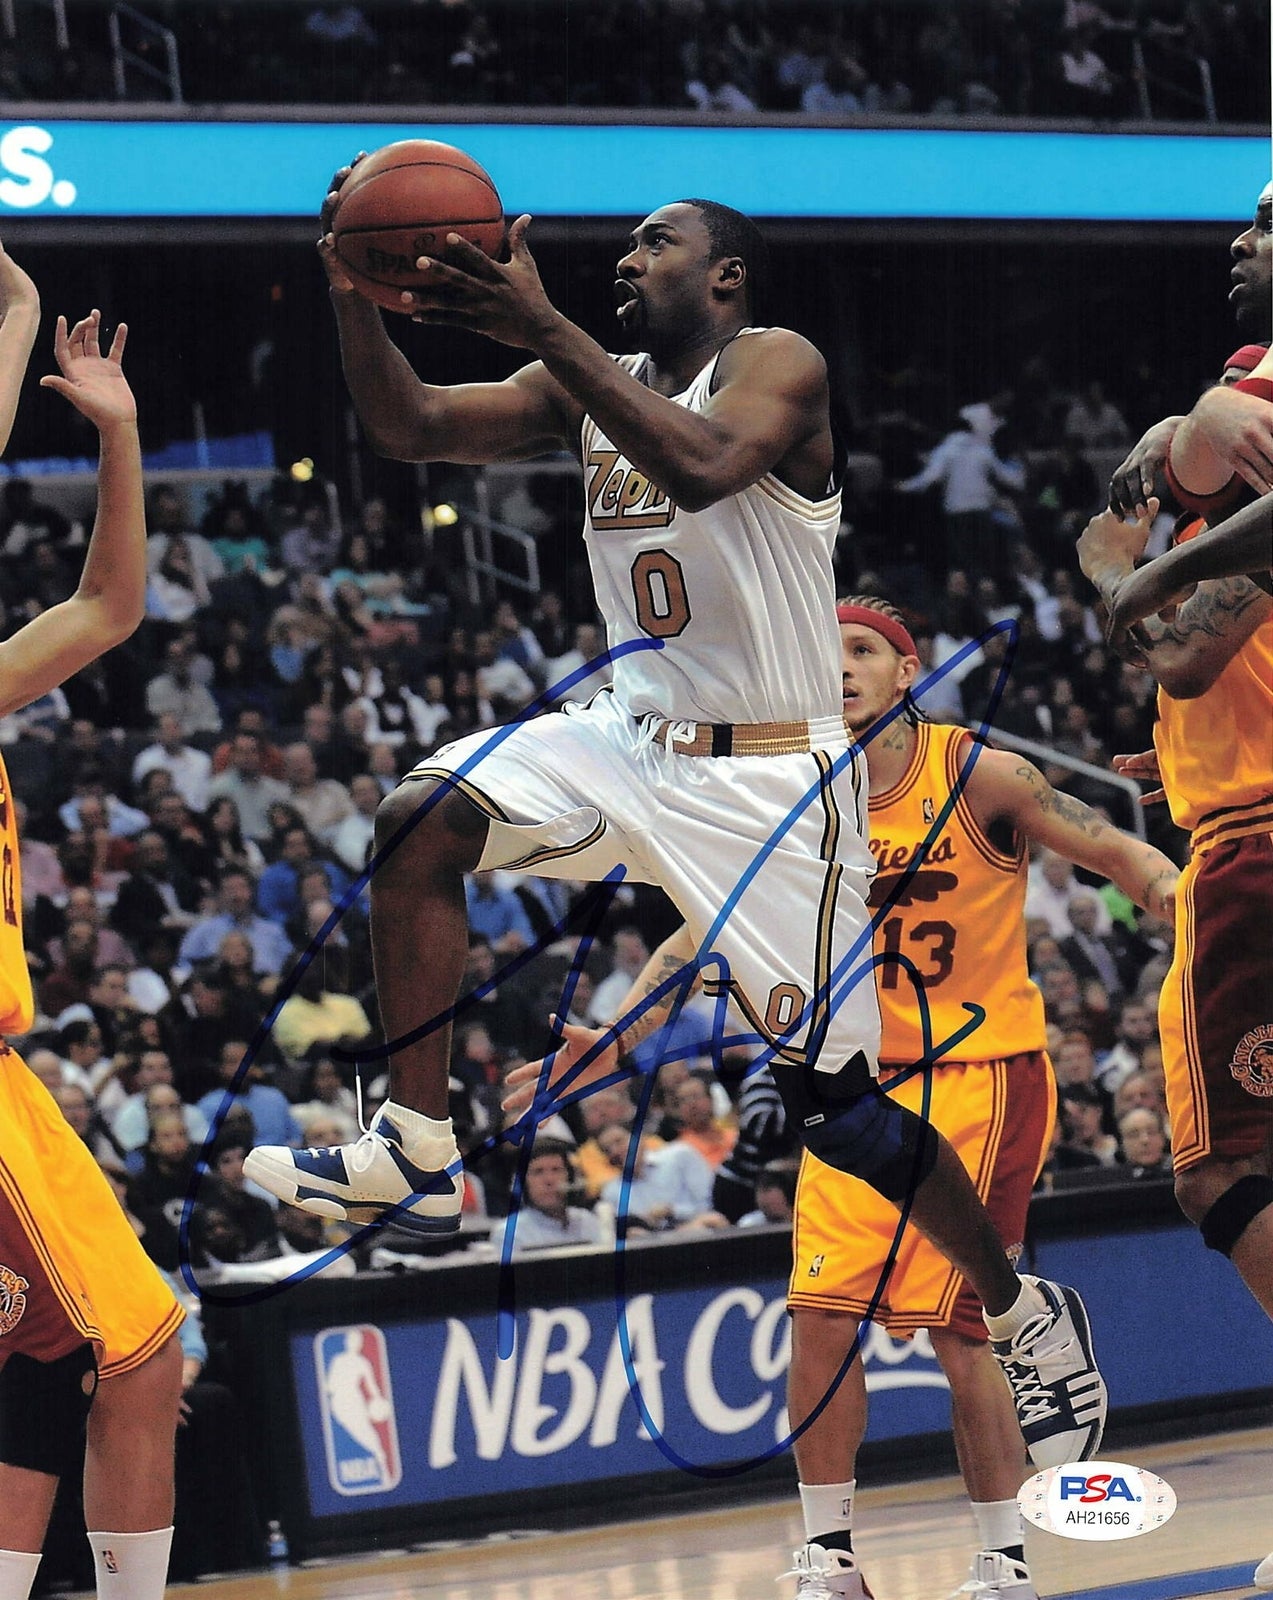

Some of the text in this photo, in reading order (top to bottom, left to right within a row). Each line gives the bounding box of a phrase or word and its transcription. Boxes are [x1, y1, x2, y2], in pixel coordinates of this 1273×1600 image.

[631, 548, 692, 639] 0
[881, 917, 956, 990] 13
[765, 982, 806, 1037] 0
[429, 1293, 666, 1469] NBA
